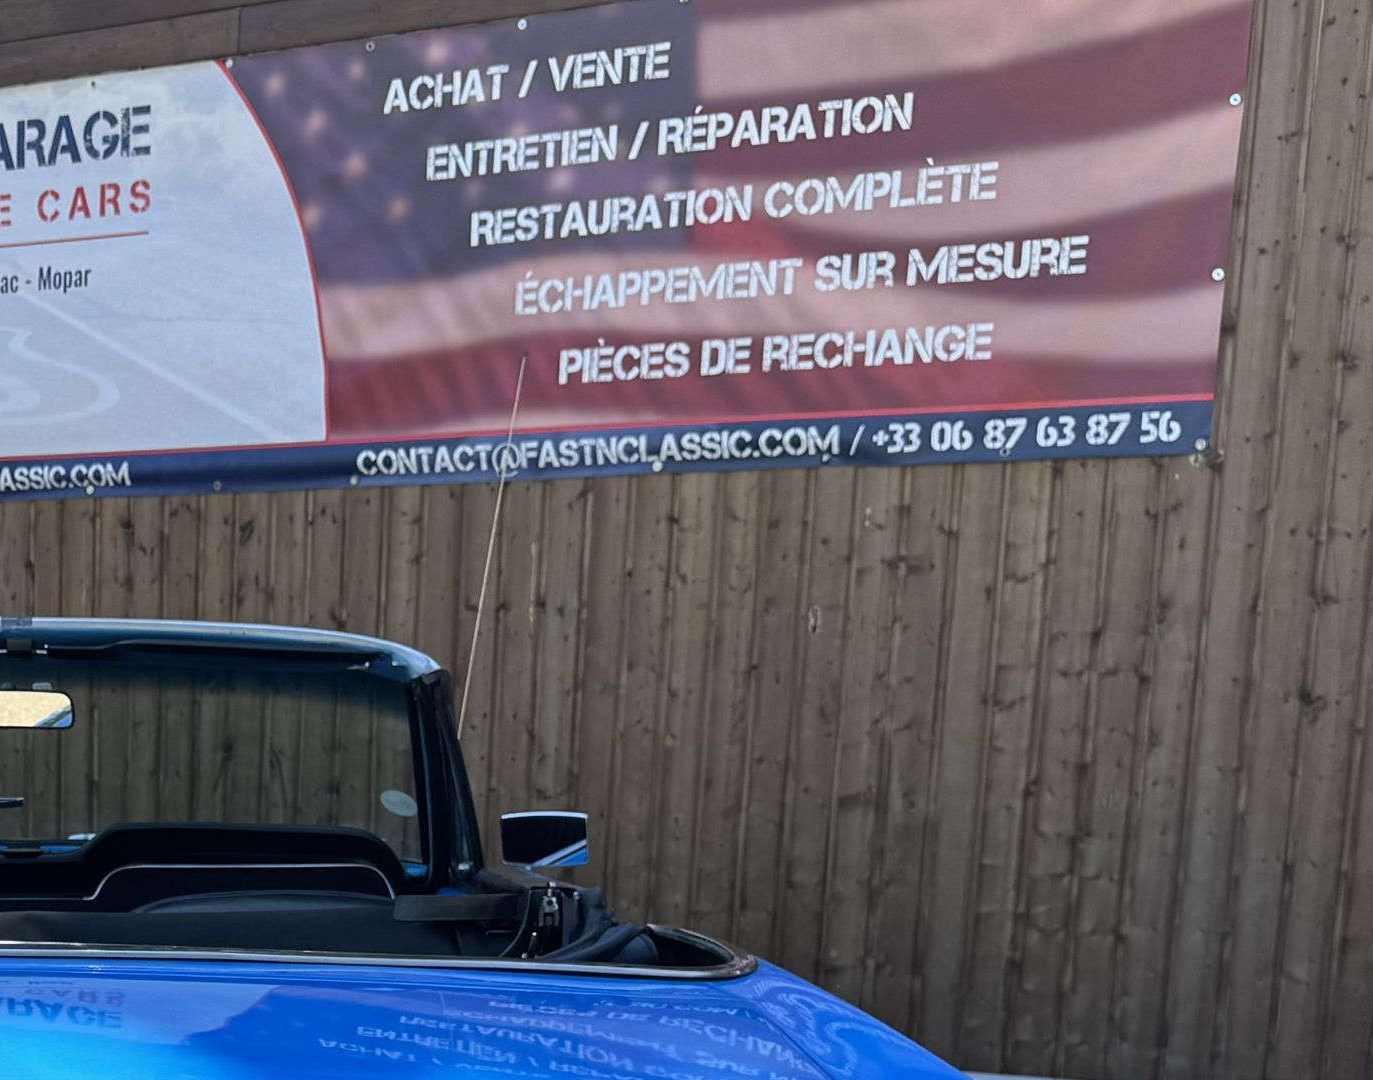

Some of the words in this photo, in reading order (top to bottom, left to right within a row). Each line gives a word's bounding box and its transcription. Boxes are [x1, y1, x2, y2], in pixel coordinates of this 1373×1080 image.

[383, 64, 509, 115] ACHAT
[519, 60, 538, 99] /
[547, 42, 671, 92] VENTE
[426, 126, 618, 182] ENTRETIEN
[628, 120, 648, 160] /
[657, 92, 914, 156] RÉPARATION
[36, 178, 152, 223] CARS
[470, 184, 752, 248] RESTAURATION
[764, 157, 999, 218] COMPLÈTE
[38, 266, 91, 294] Mopar
[514, 257, 803, 317] ÉCHAPPEMENT
[814, 249, 895, 292] SUR
[906, 235, 1090, 287] MESURE
[557, 338, 690, 386] PIÈCES
[700, 333, 752, 377] DE
[761, 323, 994, 373] RECHANGE
[356, 426, 840, 478] CONTACT@FASTNCLASSIC.COM
[849, 424, 865, 456] /
[872, 421, 922, 454] +33
[930, 420, 974, 452] 06
[983, 417, 1027, 450] 87
[1036, 416, 1076, 447] 63
[1086, 413, 1131, 446] 87
[1139, 410, 1181, 443] 56
